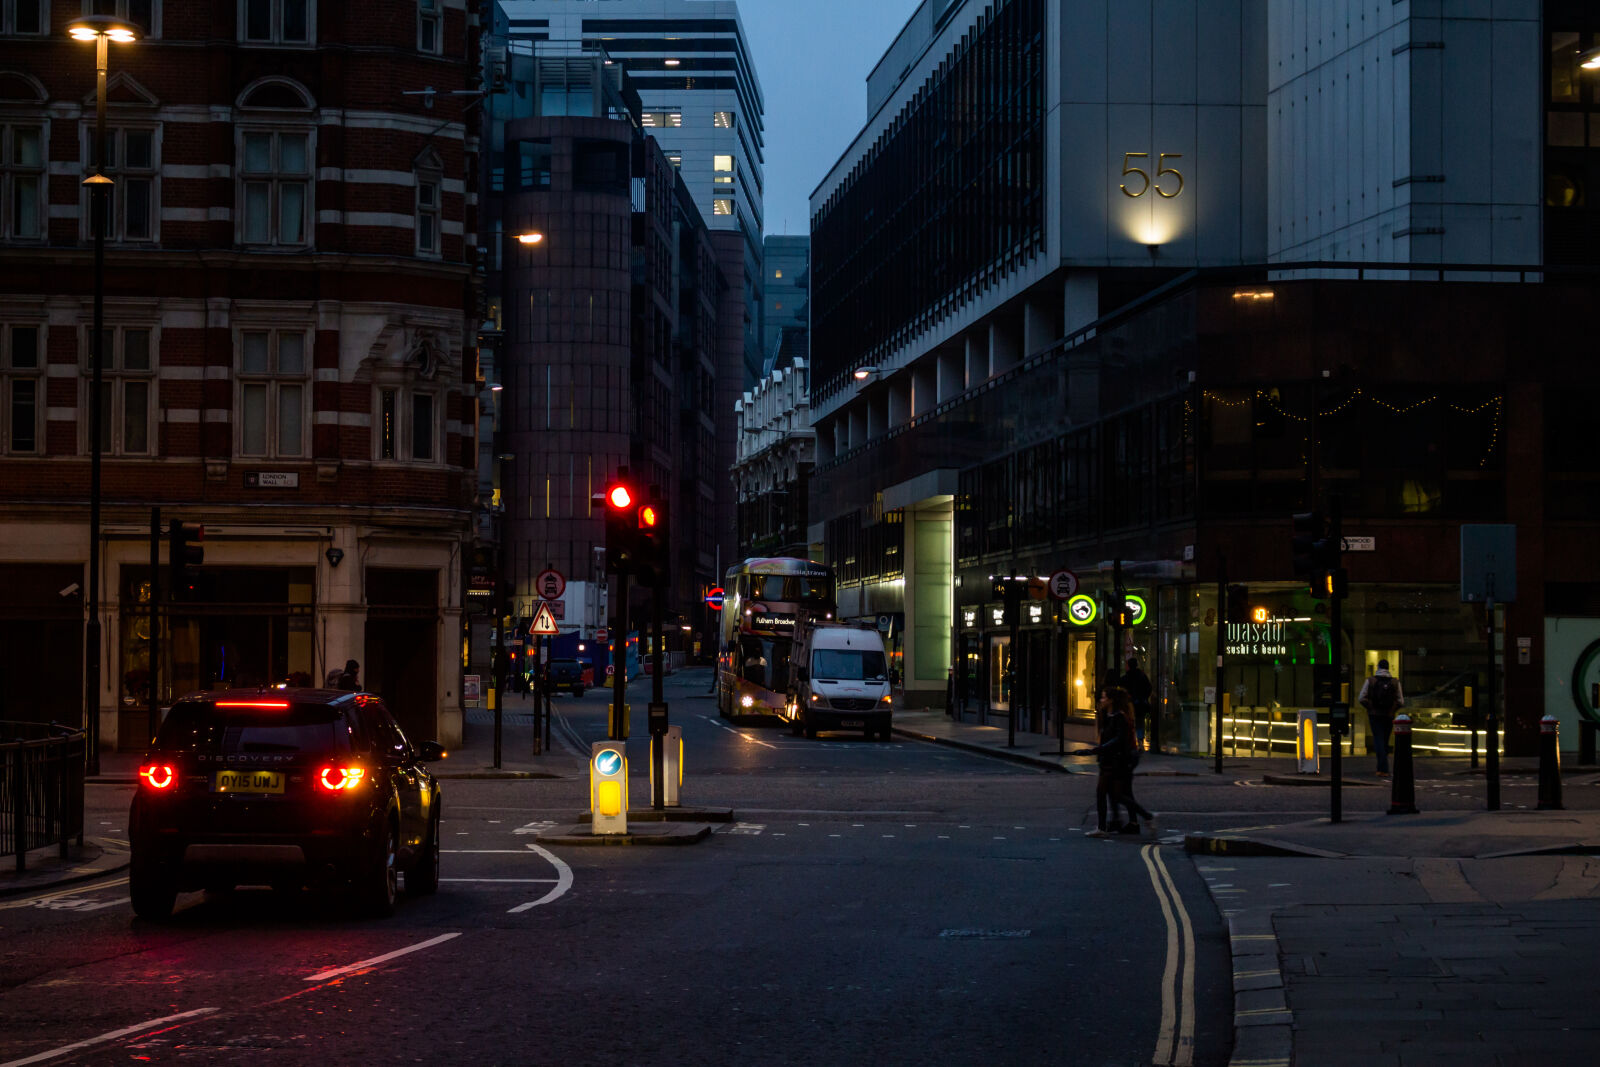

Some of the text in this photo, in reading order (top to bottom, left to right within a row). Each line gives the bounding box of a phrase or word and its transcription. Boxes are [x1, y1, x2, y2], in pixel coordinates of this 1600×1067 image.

[1120, 152, 1184, 197] 55
[1228, 614, 1286, 642] wasabi
[1226, 644, 1250, 655] sushi
[1262, 644, 1286, 655] bento
